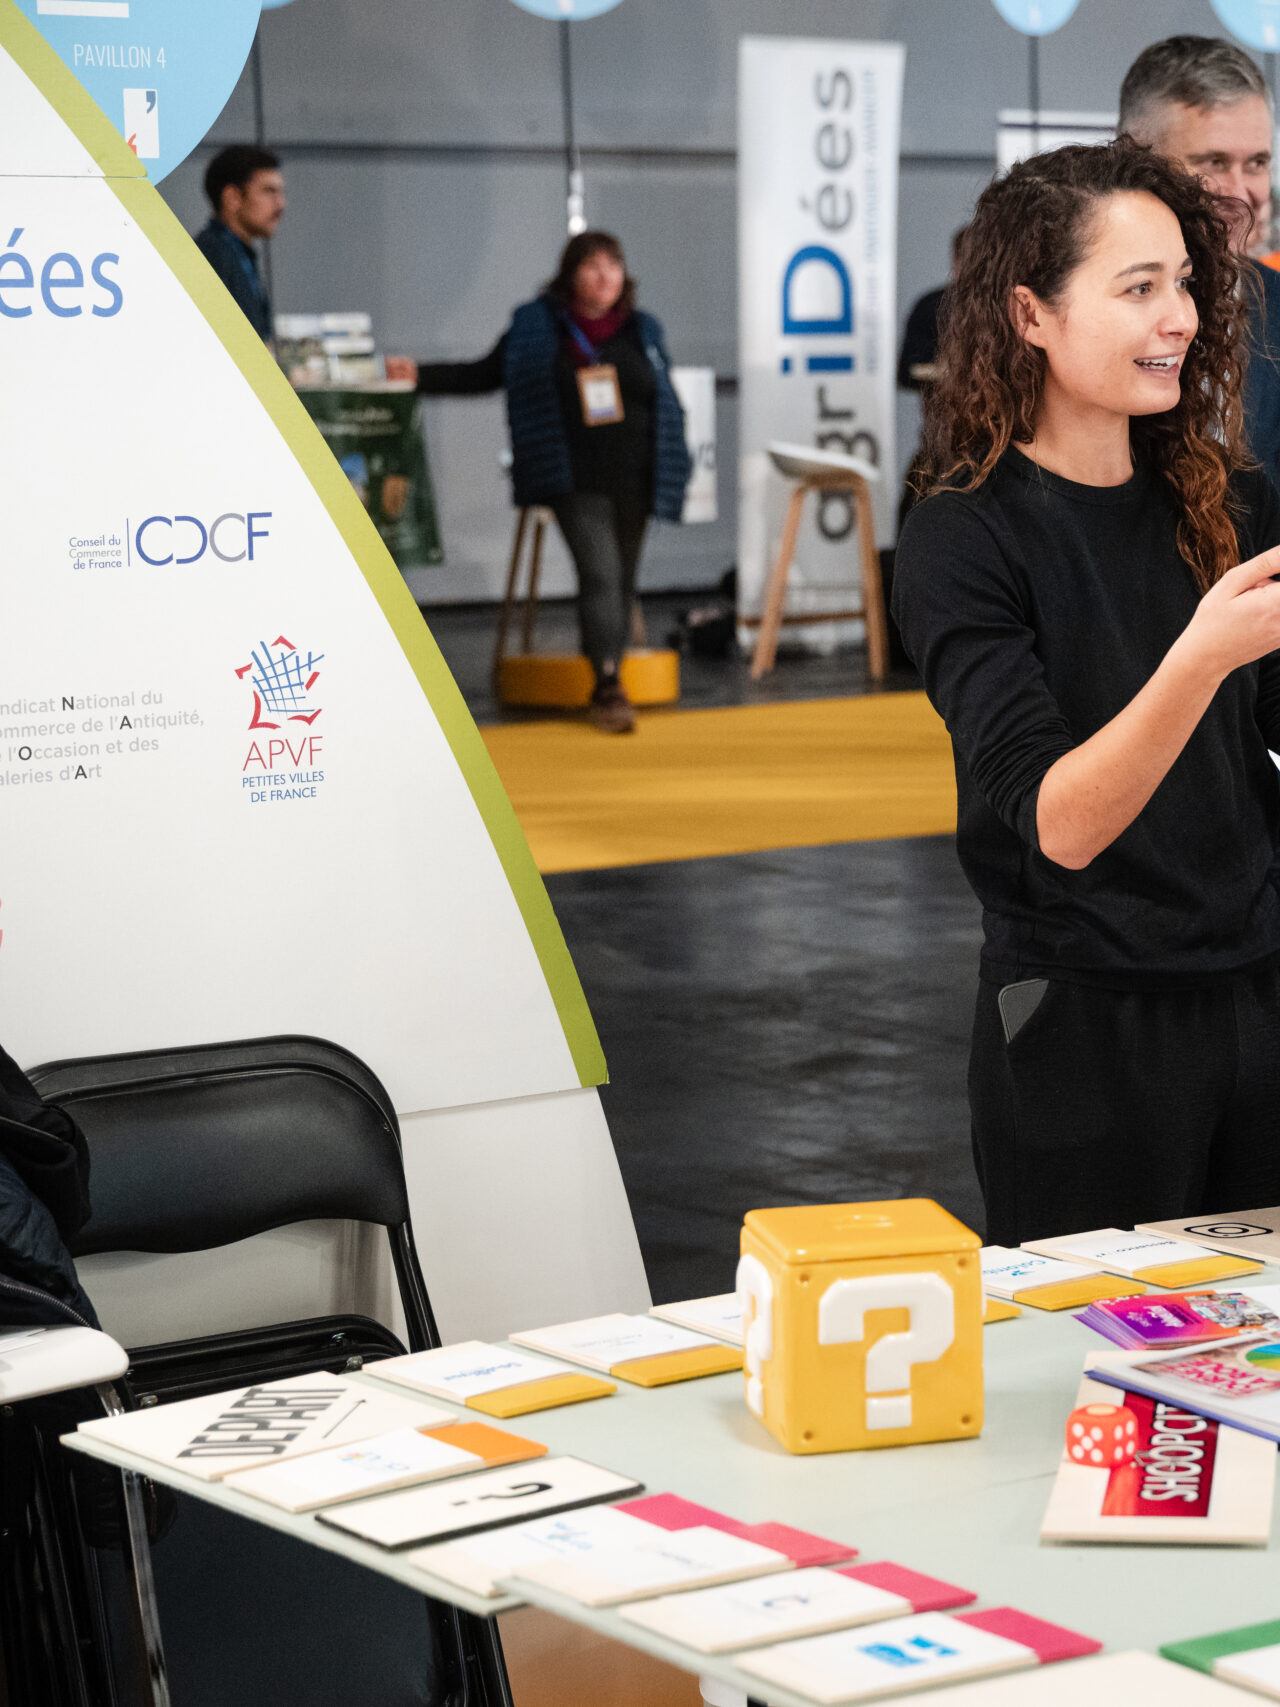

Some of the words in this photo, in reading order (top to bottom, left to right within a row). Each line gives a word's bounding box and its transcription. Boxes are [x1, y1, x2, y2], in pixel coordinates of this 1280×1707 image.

[73, 43, 151, 69] PAVILLON
[156, 47, 167, 69] 4
[68, 535, 105, 548] Conseil
[108, 534, 121, 546] du
[68, 548, 122, 560] Commerce
[73, 559, 86, 569] de
[88, 558, 122, 569] France
[62, 691, 136, 711] National
[141, 690, 164, 705] du
[81, 718, 104, 733] de
[109, 709, 205, 731] l'Antiquité,
[8, 741, 100, 762] l'Occasion
[105, 739, 123, 754] et
[128, 736, 160, 753] des
[242, 735, 324, 772] APVF
[59, 763, 103, 781] d'Art
[242, 773, 286, 788] PETITES
[289, 770, 325, 784] VILLES
[250, 790, 267, 803] DE
[270, 786, 317, 801] FRANCE
[818, 1272, 955, 1430] ?
[177, 1388, 347, 1459] DEPART
